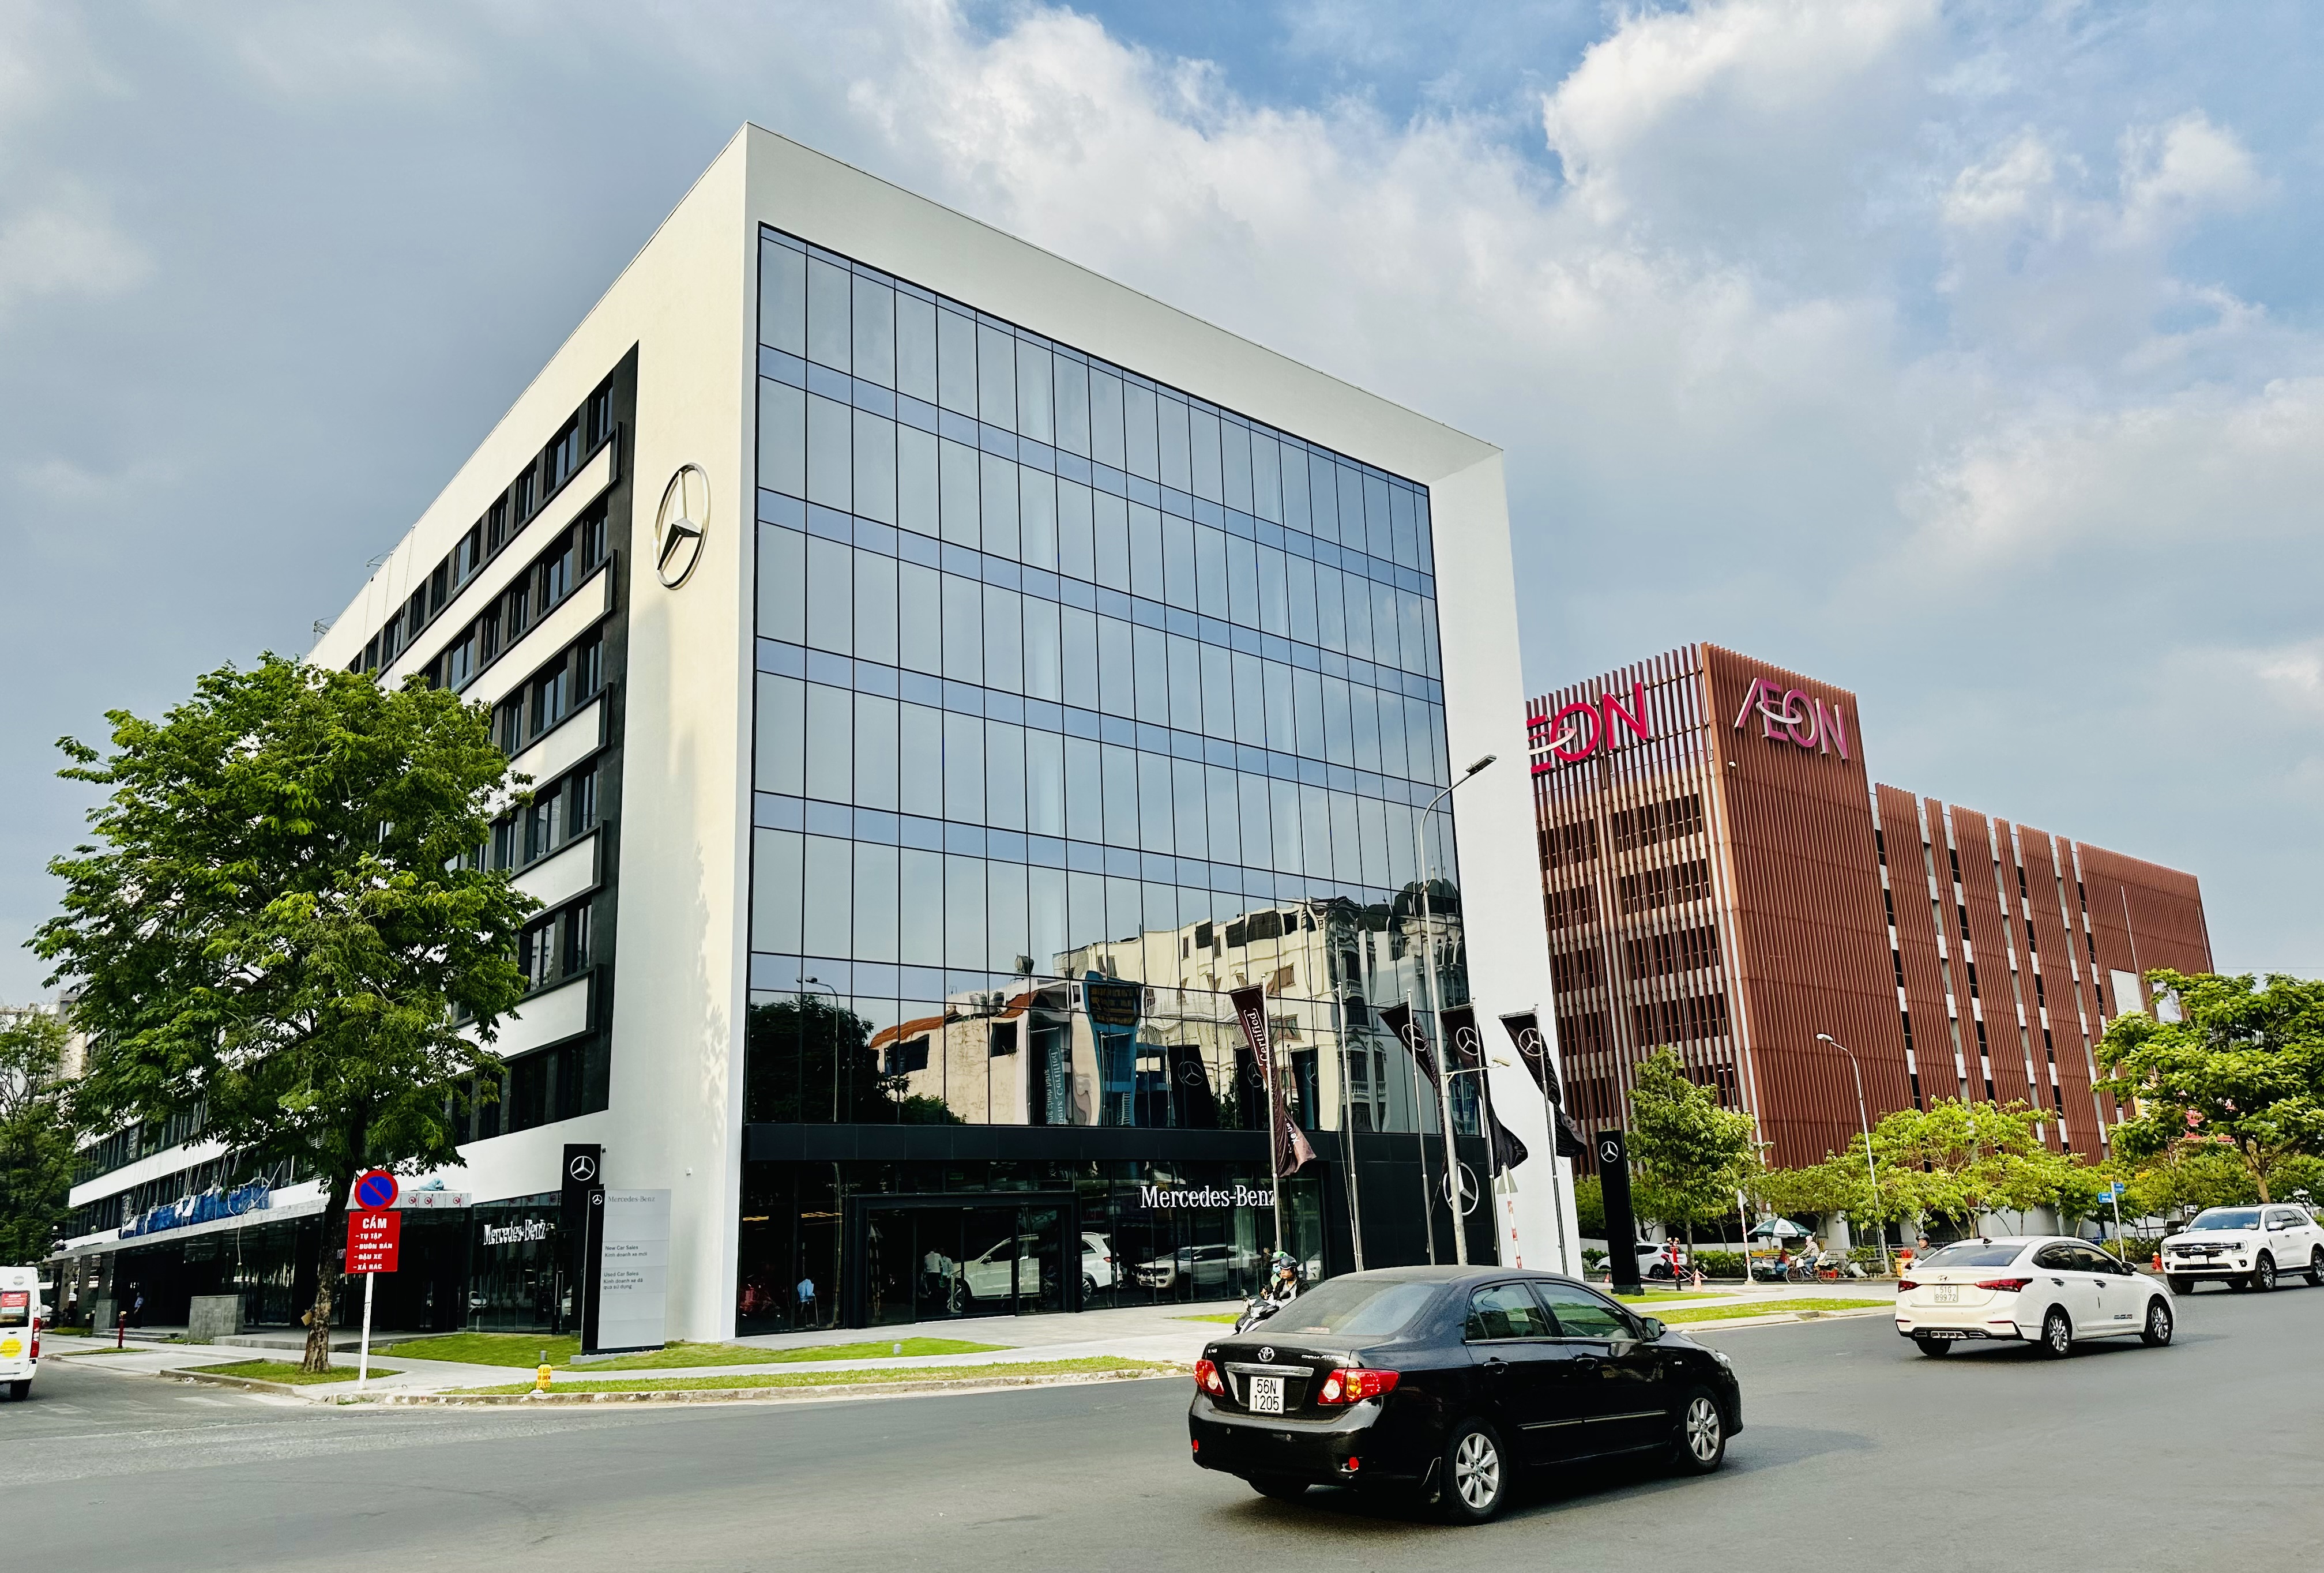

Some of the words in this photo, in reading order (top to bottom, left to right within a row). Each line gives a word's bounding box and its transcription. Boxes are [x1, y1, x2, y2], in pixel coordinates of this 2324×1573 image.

[1140, 1184, 1274, 1208] Mercedes-Benz
[483, 1219, 546, 1245] Mercedes-Benz
[1257, 1379, 1276, 1394] 56N
[1254, 1395, 1279, 1411] 1205
